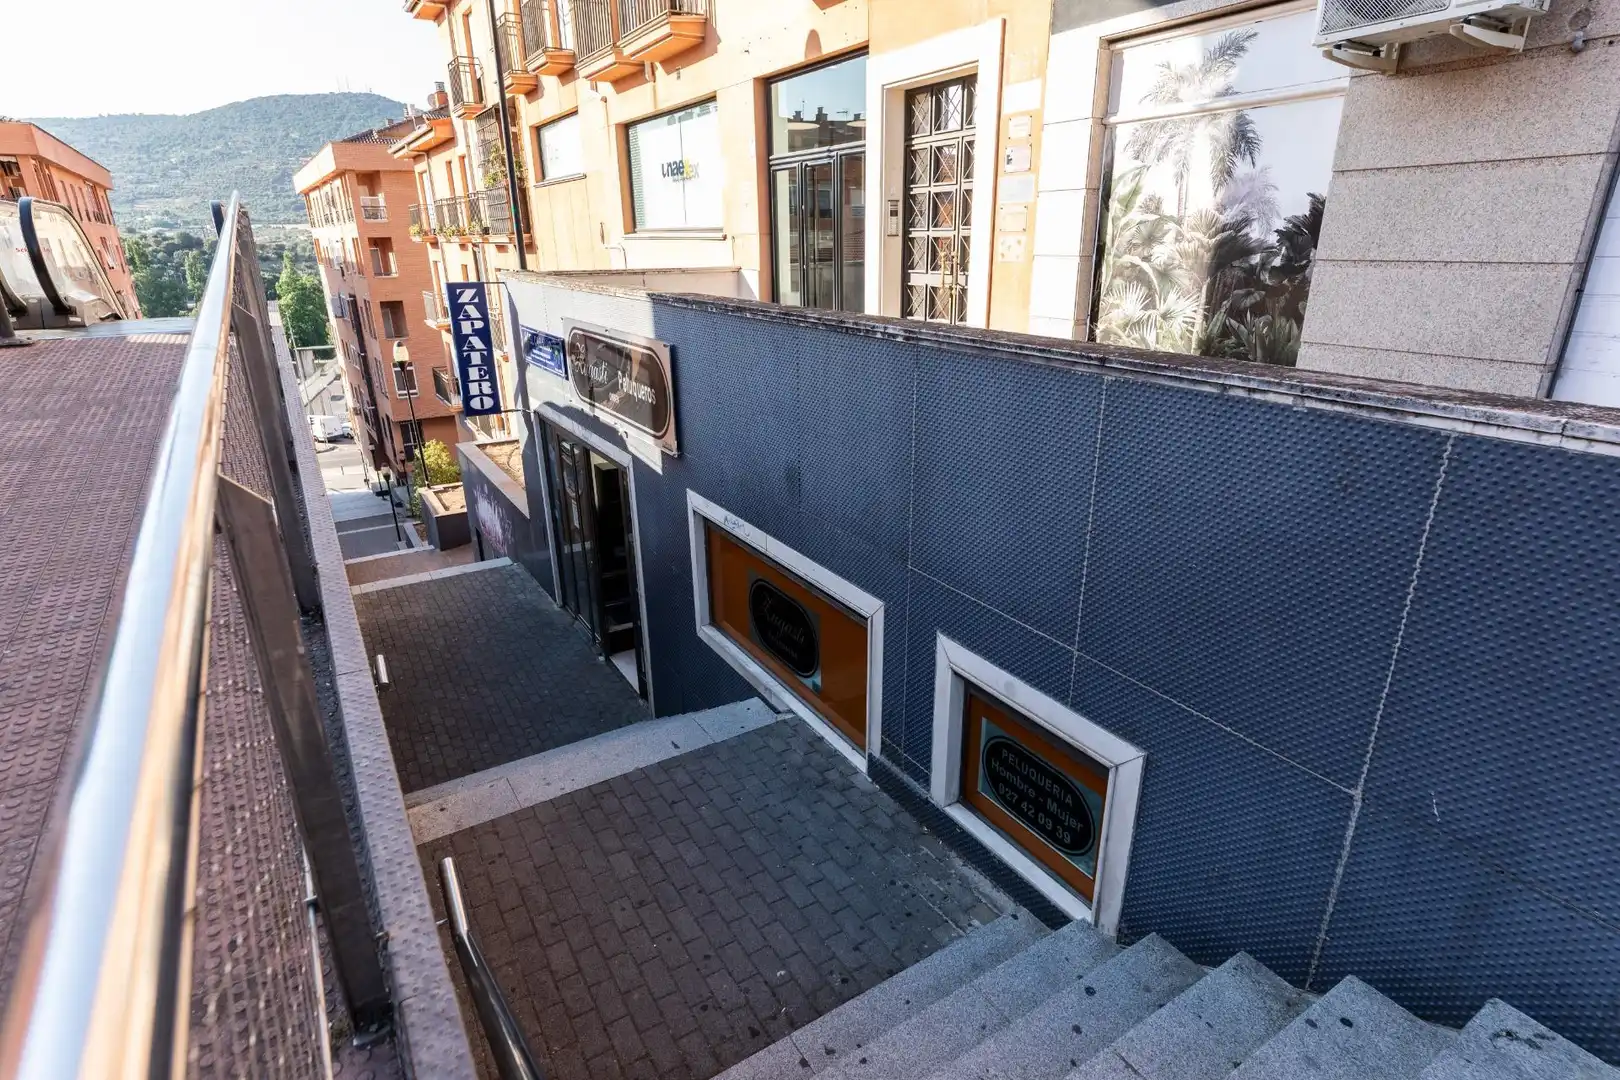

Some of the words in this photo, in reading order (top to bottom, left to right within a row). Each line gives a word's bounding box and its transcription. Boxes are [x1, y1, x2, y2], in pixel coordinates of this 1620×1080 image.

[456, 288, 494, 411] ZAPATERO
[618, 371, 657, 405] Peluqueros
[991, 758, 1036, 798] Hombre
[1047, 798, 1084, 833] Mujer
[1001, 748, 1073, 807] PELUQUERIA
[1020, 802, 1035, 819] 42
[1056, 825, 1071, 844] 39
